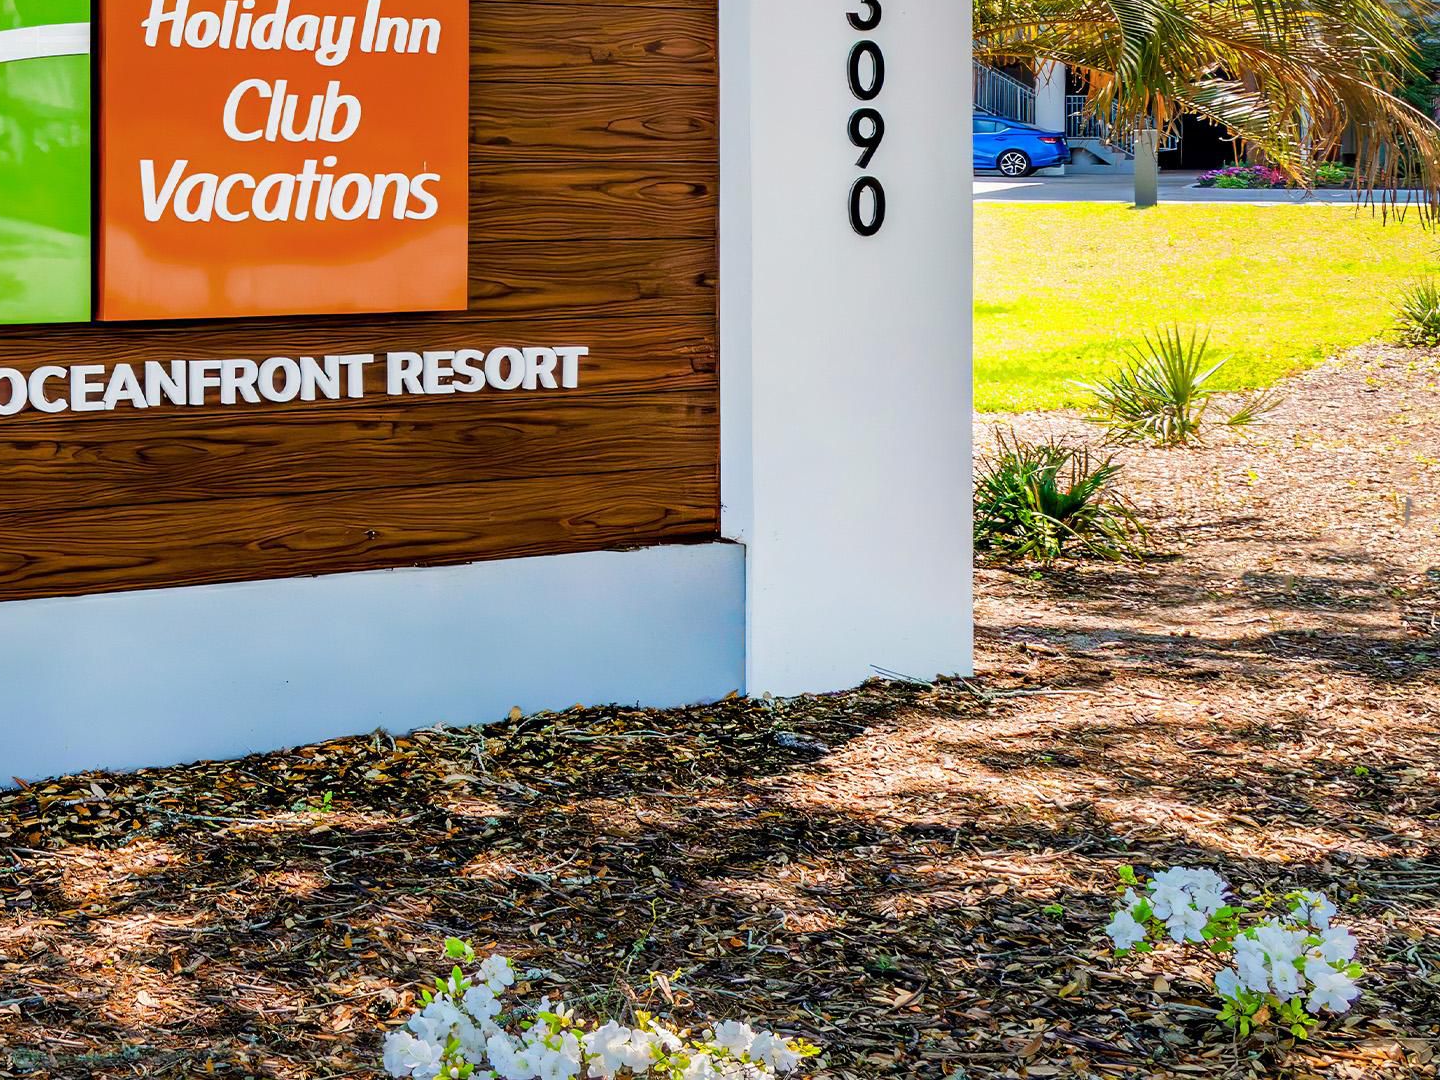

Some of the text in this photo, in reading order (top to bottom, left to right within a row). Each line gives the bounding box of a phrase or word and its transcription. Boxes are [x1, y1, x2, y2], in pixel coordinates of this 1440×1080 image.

[222, 78, 362, 143] Club
[139, 156, 441, 224] Vacations
[385, 345, 589, 396] RESORT
